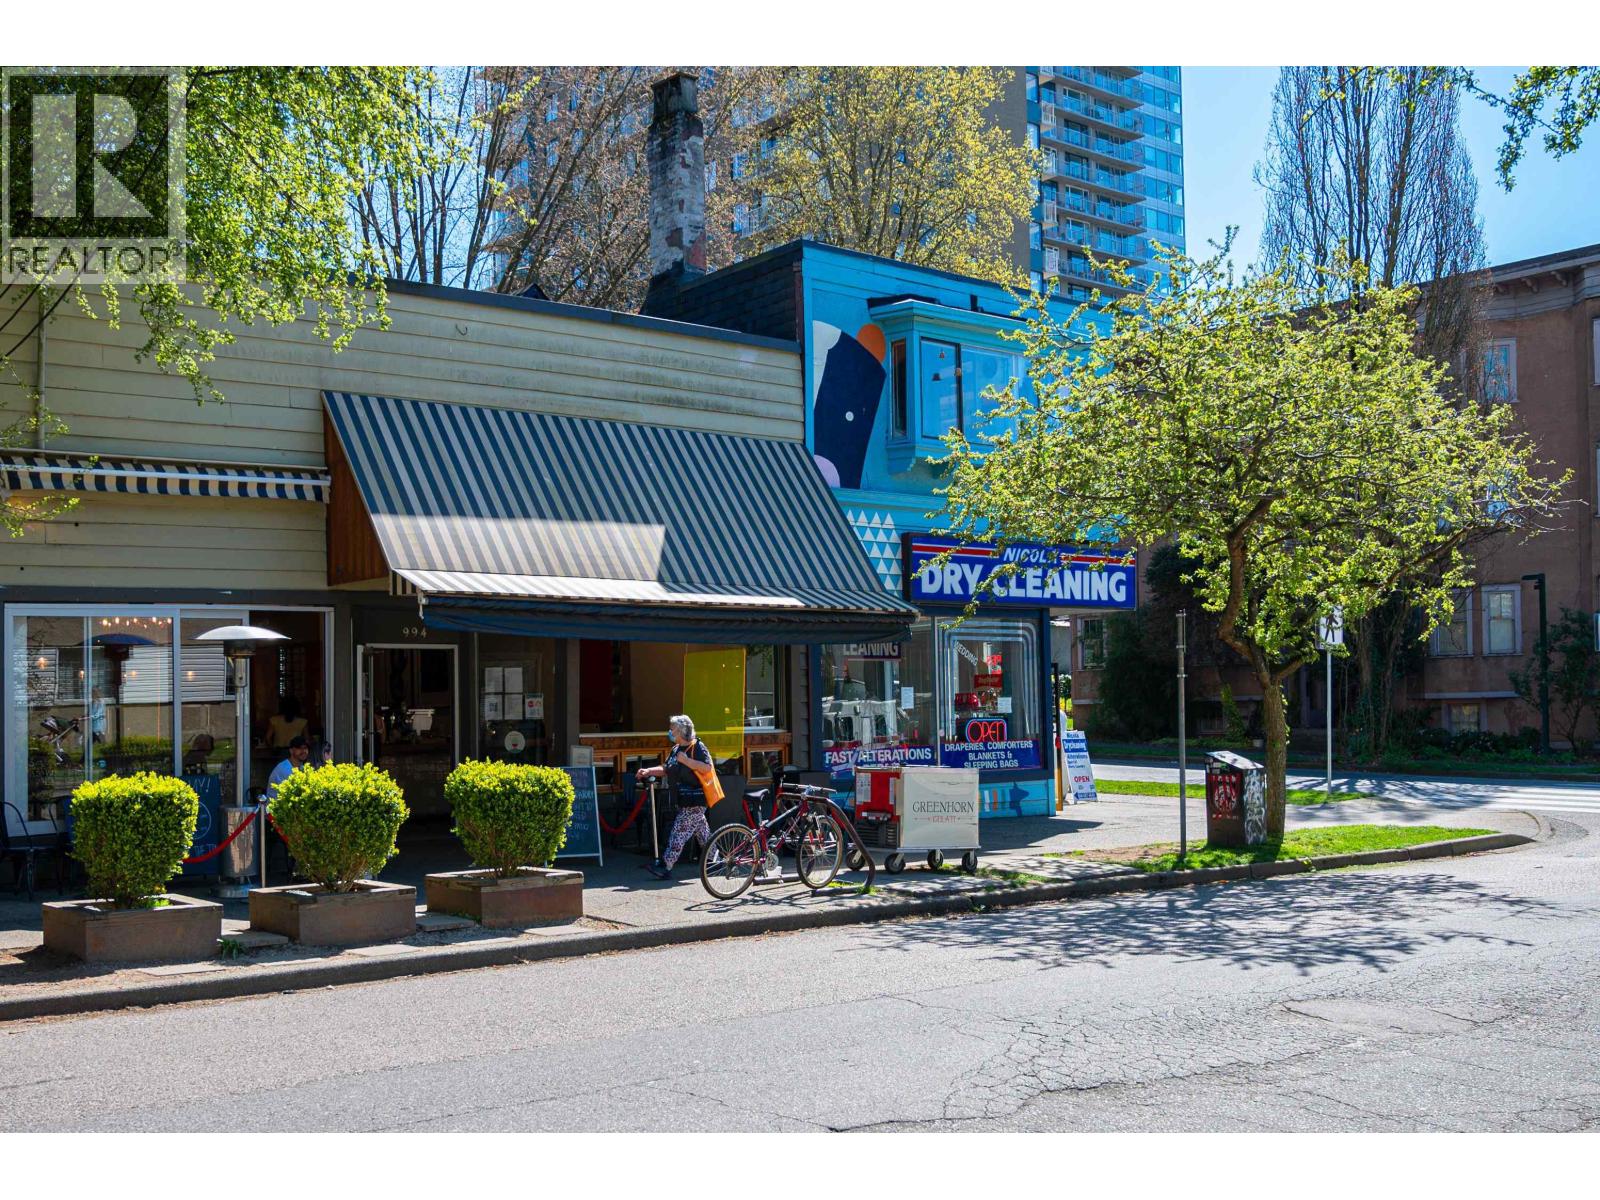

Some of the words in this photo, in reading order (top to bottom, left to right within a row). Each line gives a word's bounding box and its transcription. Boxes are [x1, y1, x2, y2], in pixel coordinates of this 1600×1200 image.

[920, 562, 983, 595] DRY
[992, 564, 1126, 602] CLEANING
[402, 627, 427, 638] 994
[968, 721, 1007, 743] OPEN
[944, 743, 985, 752] DRAPERIES,
[987, 740, 1034, 750] COMFORTERS
[825, 751, 853, 764] FAST
[857, 748, 931, 762] ALTERATIONS
[968, 751, 1006, 761] BLANKETS
[963, 760, 998, 768] SLEEPING
[999, 759, 1019, 768] BAGS
[912, 801, 975, 813] GREENHORN
